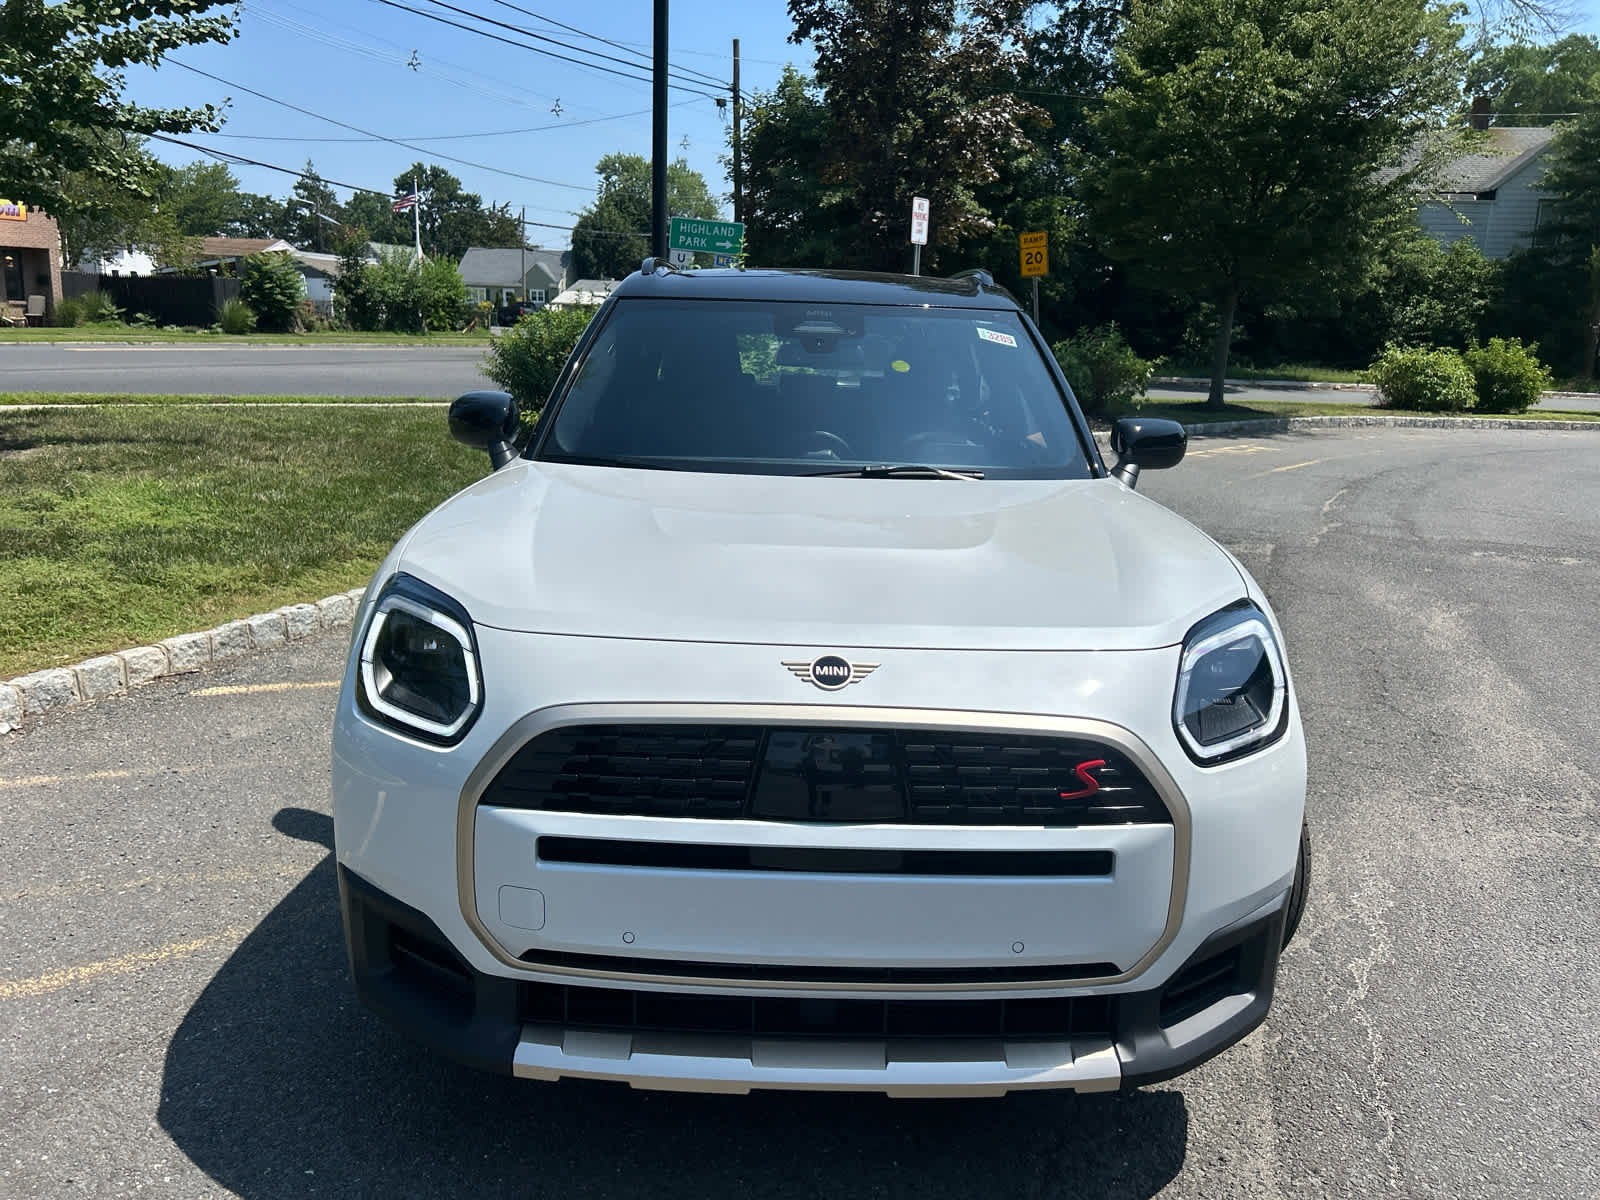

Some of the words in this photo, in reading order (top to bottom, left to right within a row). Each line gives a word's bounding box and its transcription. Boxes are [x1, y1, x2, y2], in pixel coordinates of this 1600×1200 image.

[680, 222, 735, 237] HIGHLAND
[679, 235, 707, 247] PARK
[1025, 251, 1043, 264] 20
[815, 665, 848, 676] MINI
[1060, 759, 1106, 800] S
